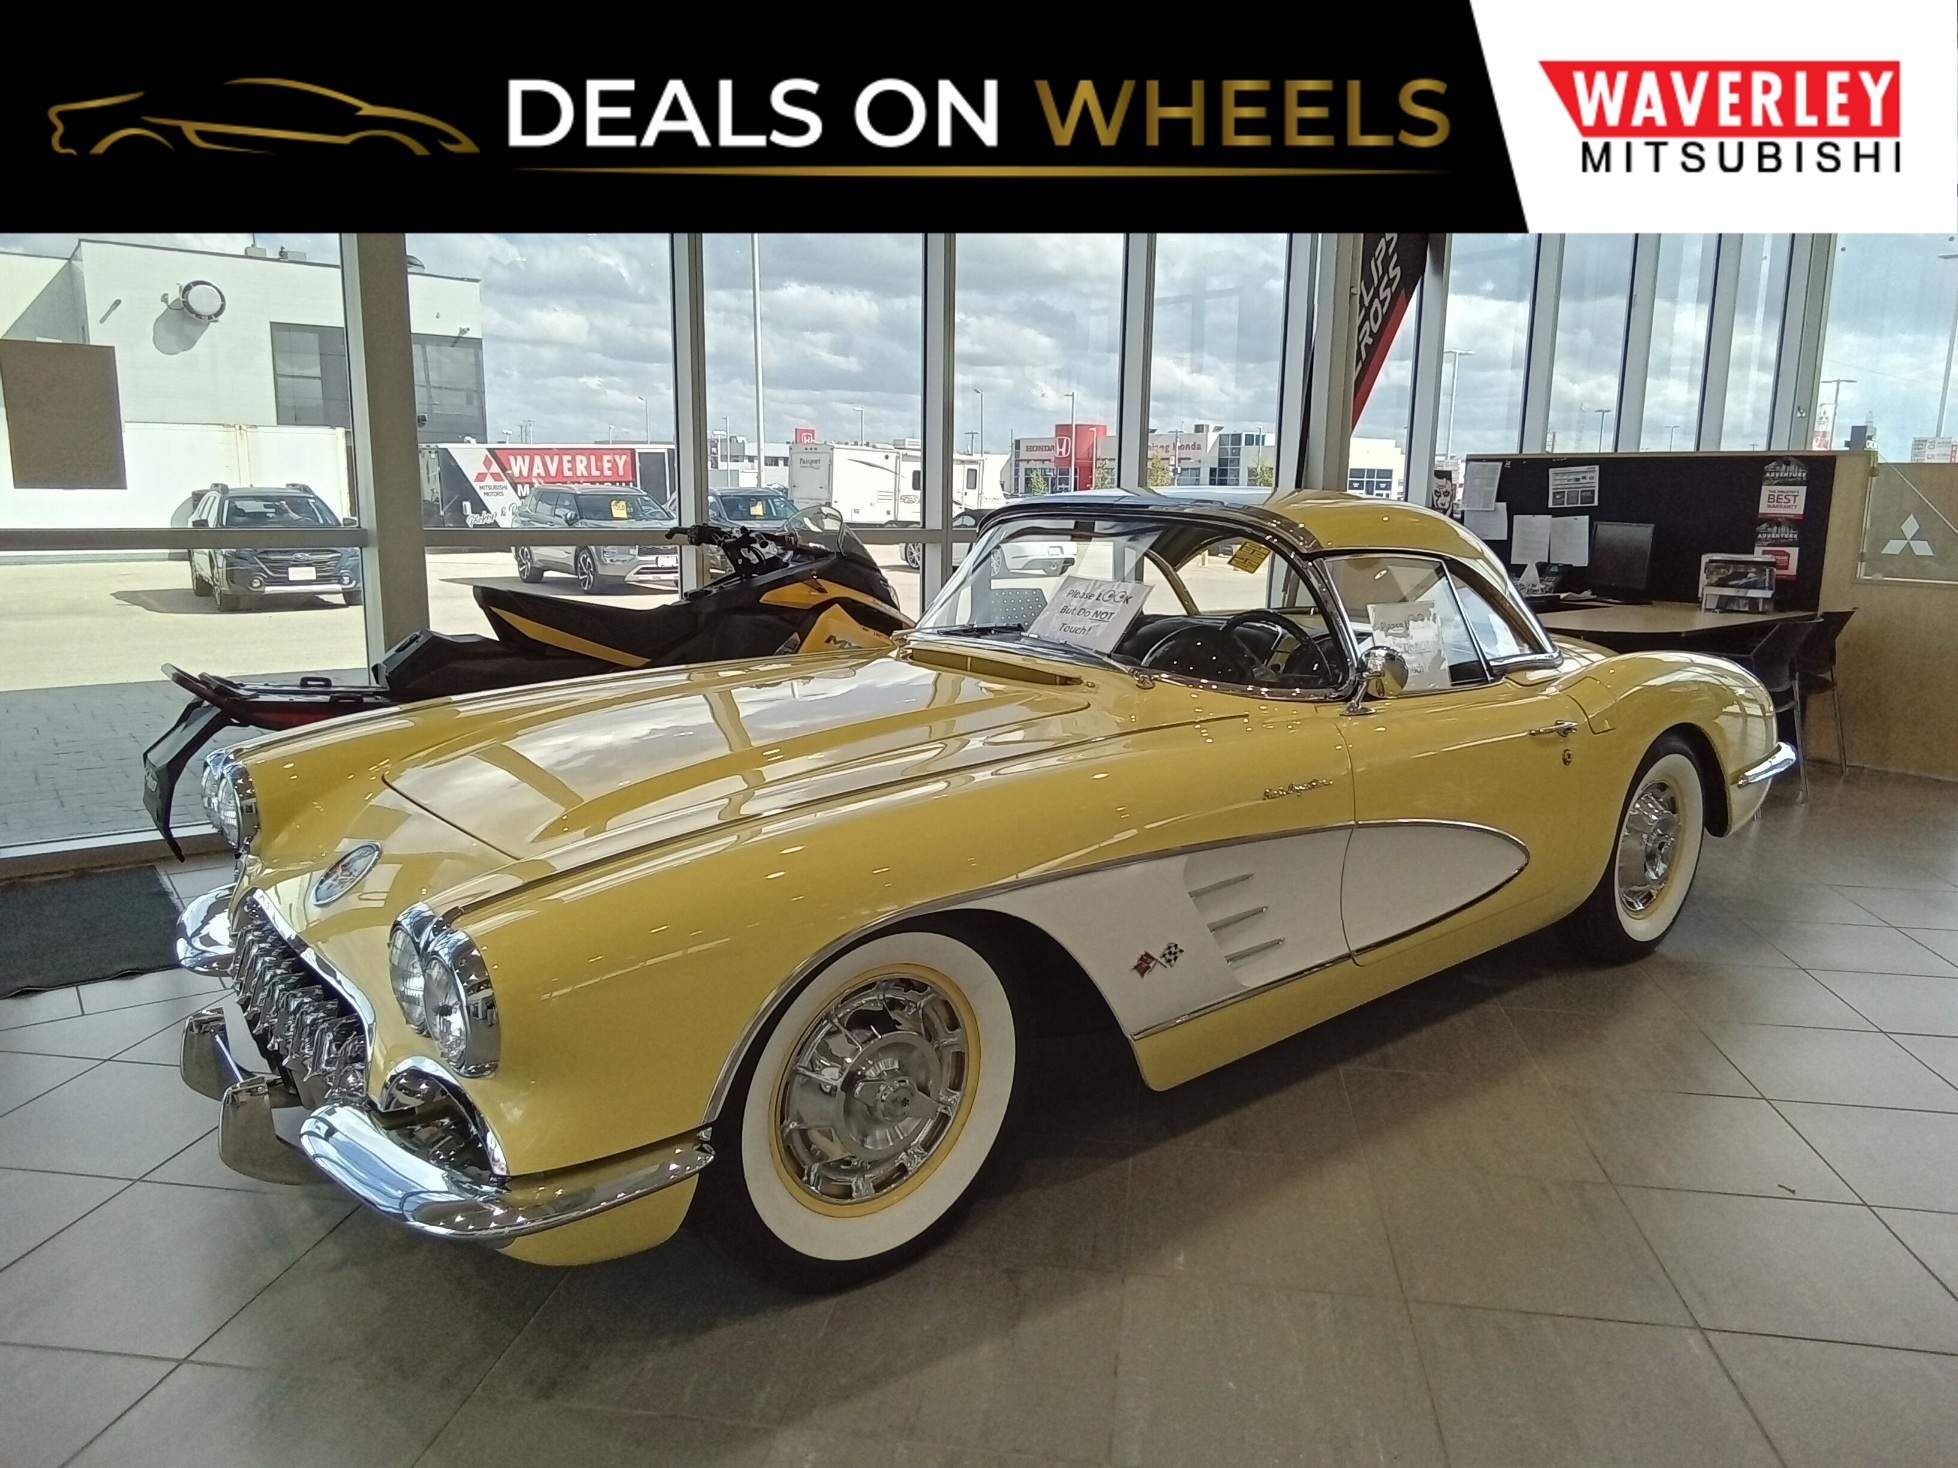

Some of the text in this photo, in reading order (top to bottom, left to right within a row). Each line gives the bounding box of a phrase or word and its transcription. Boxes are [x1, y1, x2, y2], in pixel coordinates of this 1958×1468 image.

[508, 454, 628, 477] WAVERLEY
[799, 457, 821, 466] Passport
[1767, 494, 1799, 504] BEST
[1066, 589, 1133, 604] Please LOOK
[1060, 605, 1116, 621] But Do NOT
[1059, 622, 1092, 635] Touch!
